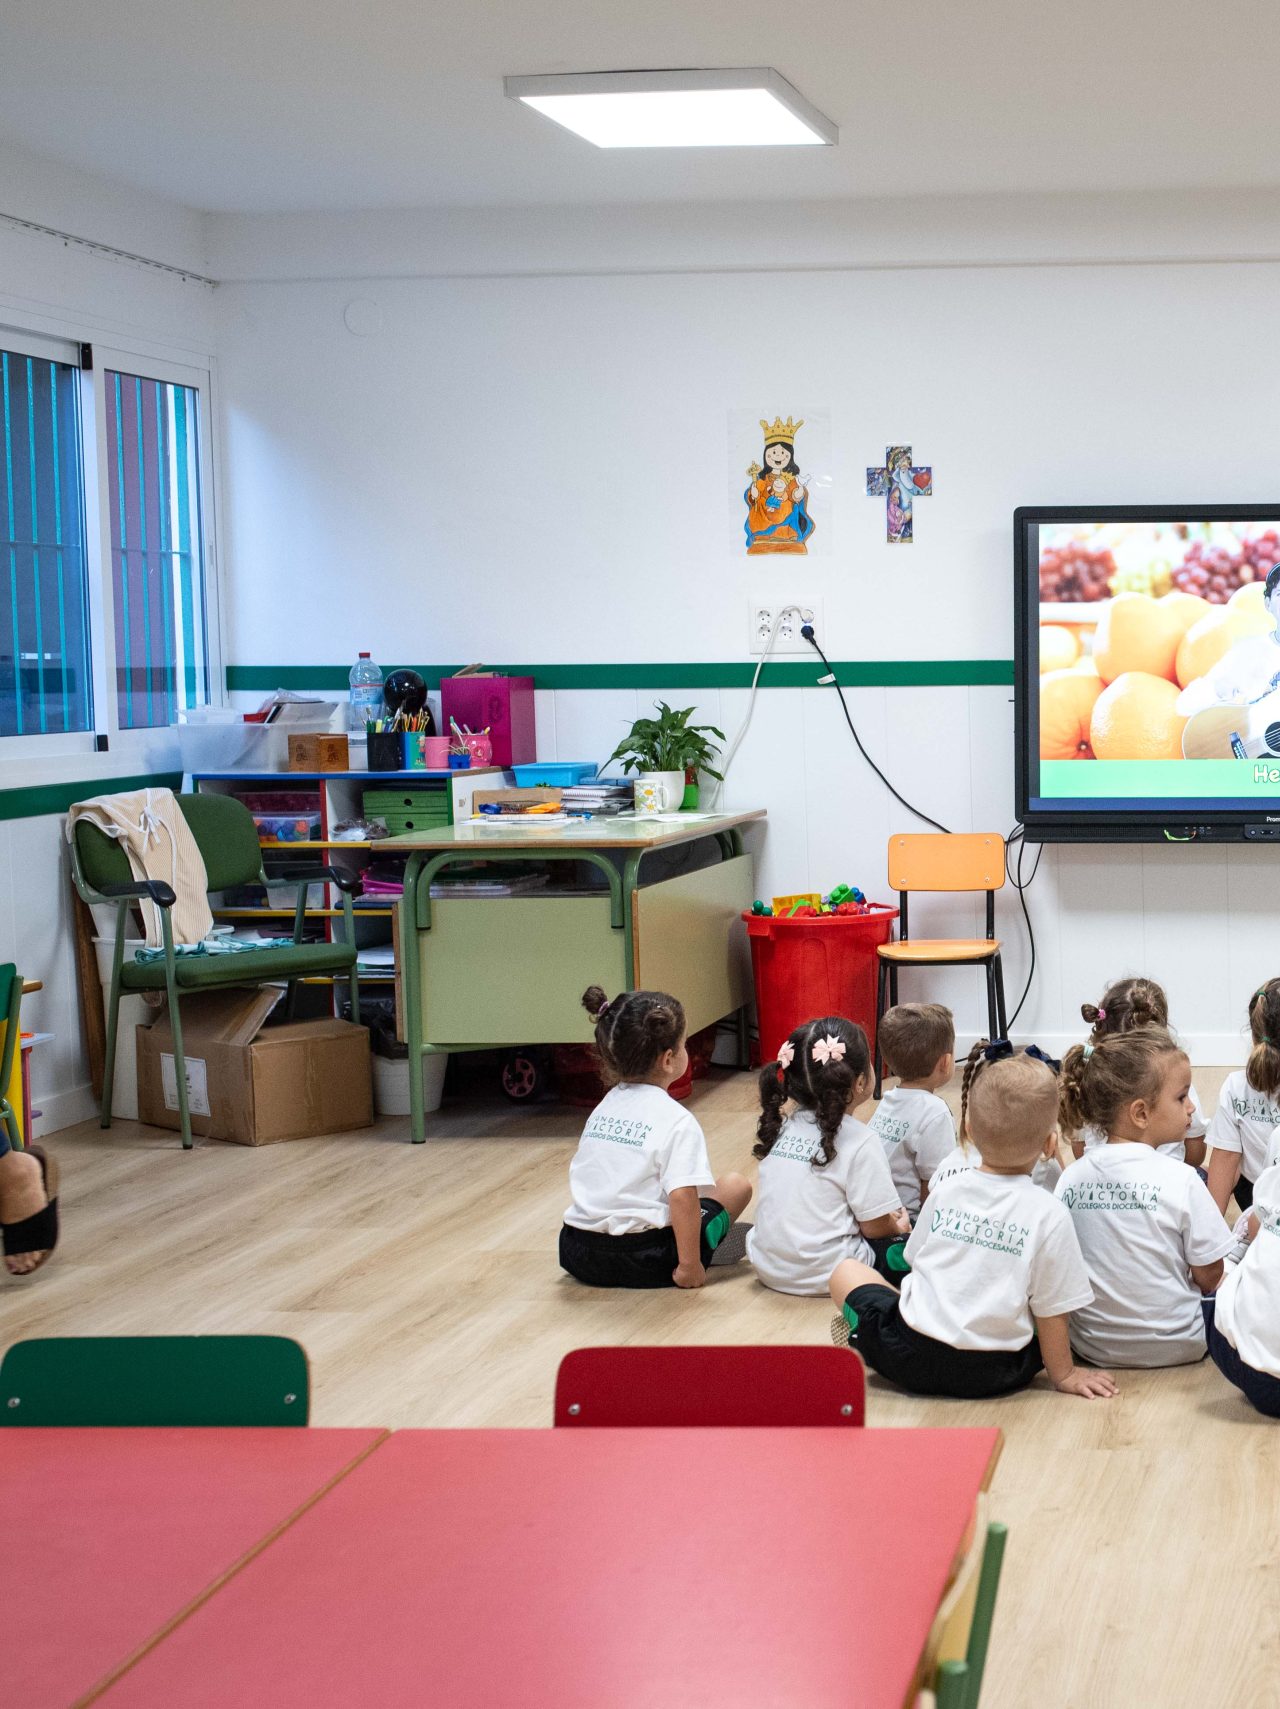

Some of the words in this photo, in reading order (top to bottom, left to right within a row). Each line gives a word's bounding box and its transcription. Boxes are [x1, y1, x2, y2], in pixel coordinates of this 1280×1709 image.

[594, 1115, 653, 1132] UNDACIÓN
[775, 1141, 821, 1156] ICTORI
[1079, 1181, 1161, 1192] FUNDACIÓN
[1080, 1190, 1158, 1203] VICTORIA
[1077, 1202, 1111, 1210] COLEGIOS
[1112, 1202, 1157, 1212] DIOCESANOS
[948, 1208, 1030, 1236] FUNDACIÓN
[945, 1217, 1025, 1248] VICTORIA
[941, 1229, 975, 1244] COLEGIOS
[975, 1237, 1022, 1257] DIOCESANOS
